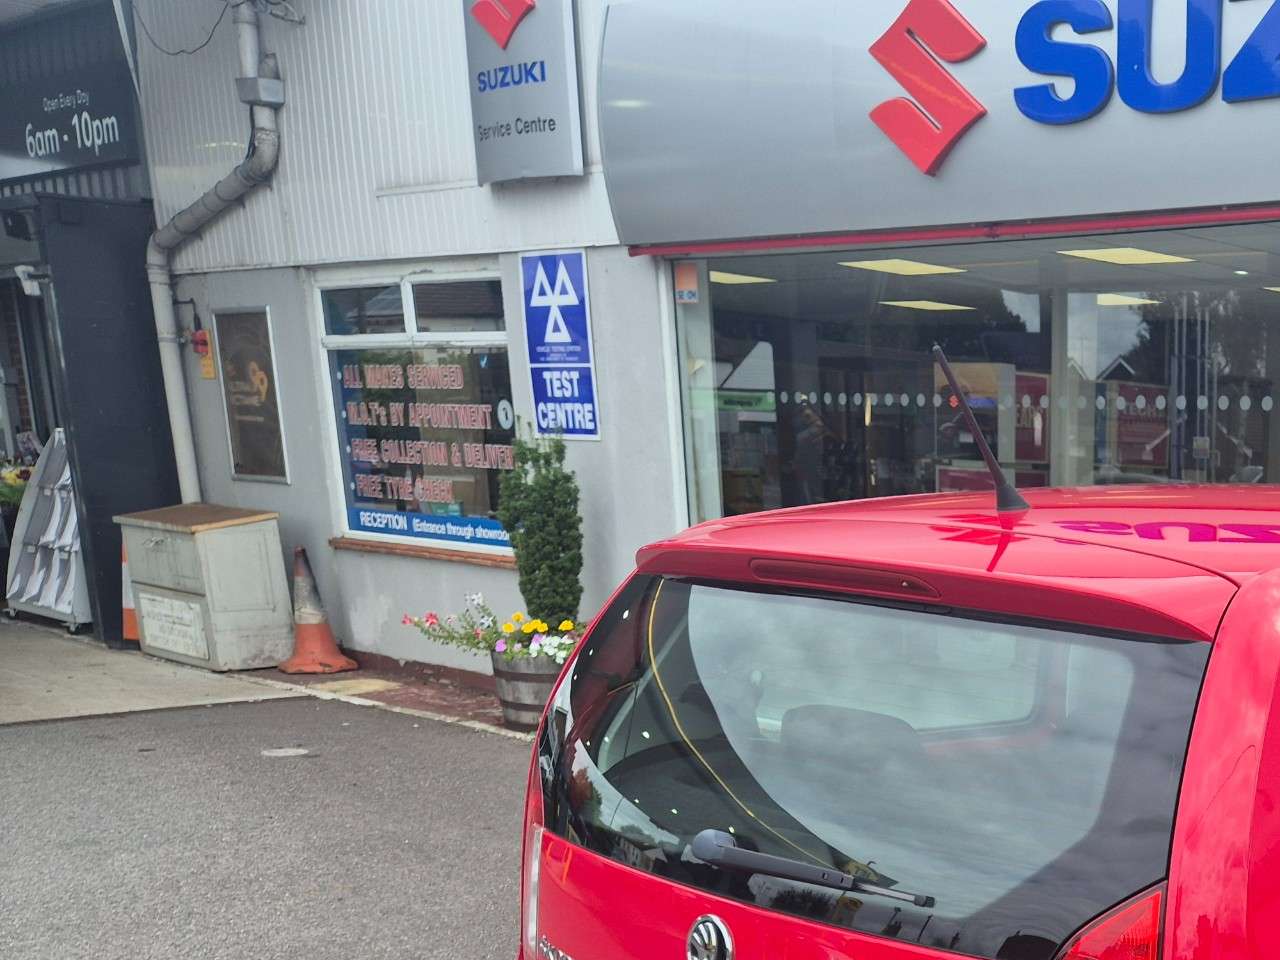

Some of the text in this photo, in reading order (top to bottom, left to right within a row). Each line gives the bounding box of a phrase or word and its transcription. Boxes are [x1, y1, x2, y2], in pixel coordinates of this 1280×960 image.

[477, 61, 547, 92] SUZUKI
[26, 123, 60, 158] 6am
[72, 111, 119, 156] 10pm
[479, 116, 556, 142] Service Centre
[343, 365, 362, 388] ALL
[407, 364, 464, 389] SERVICED
[542, 370, 580, 397] TEST
[389, 403, 405, 427] BY
[408, 403, 492, 429] APPOINTMENT
[537, 401, 595, 430] CENTRE
[351, 438, 379, 462] FREE
[381, 439, 448, 466] COLLECTION
[450, 443, 462, 467] &
[355, 473, 383, 499] FREE
[385, 475, 413, 500] TYRE
[360, 511, 408, 531] RECEPTION
[446, 522, 475, 540] through
